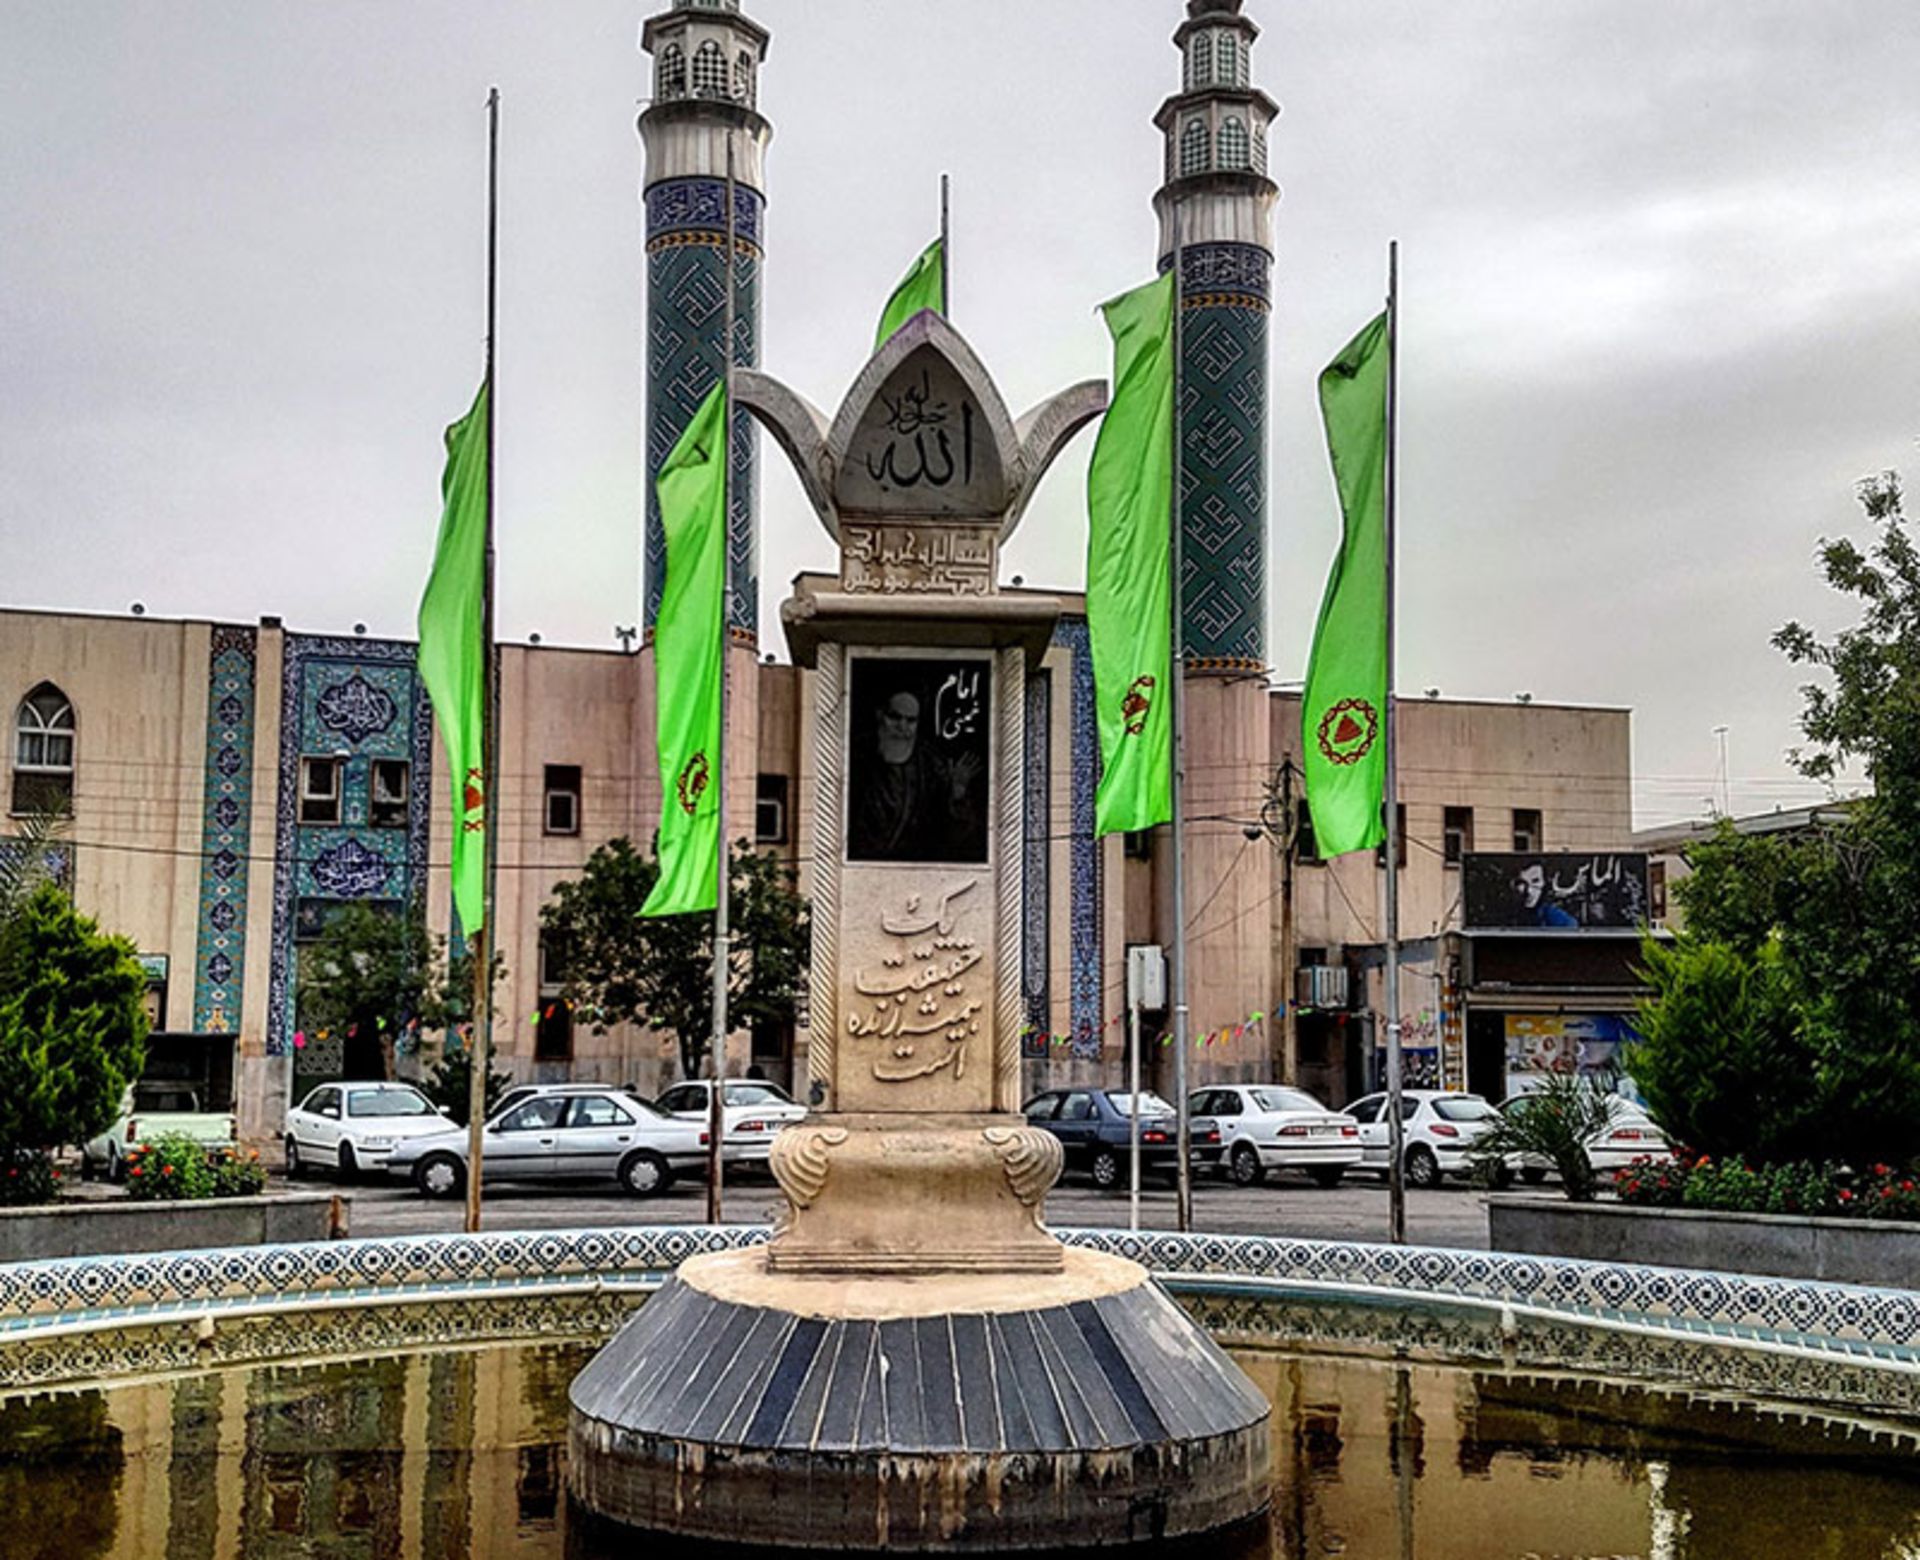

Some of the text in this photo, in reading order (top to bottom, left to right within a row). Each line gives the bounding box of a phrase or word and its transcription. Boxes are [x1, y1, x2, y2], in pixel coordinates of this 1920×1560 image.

[866, 395, 974, 488] الله
[855, 937, 984, 997] حقیقت
[872, 1042, 968, 1083] است
